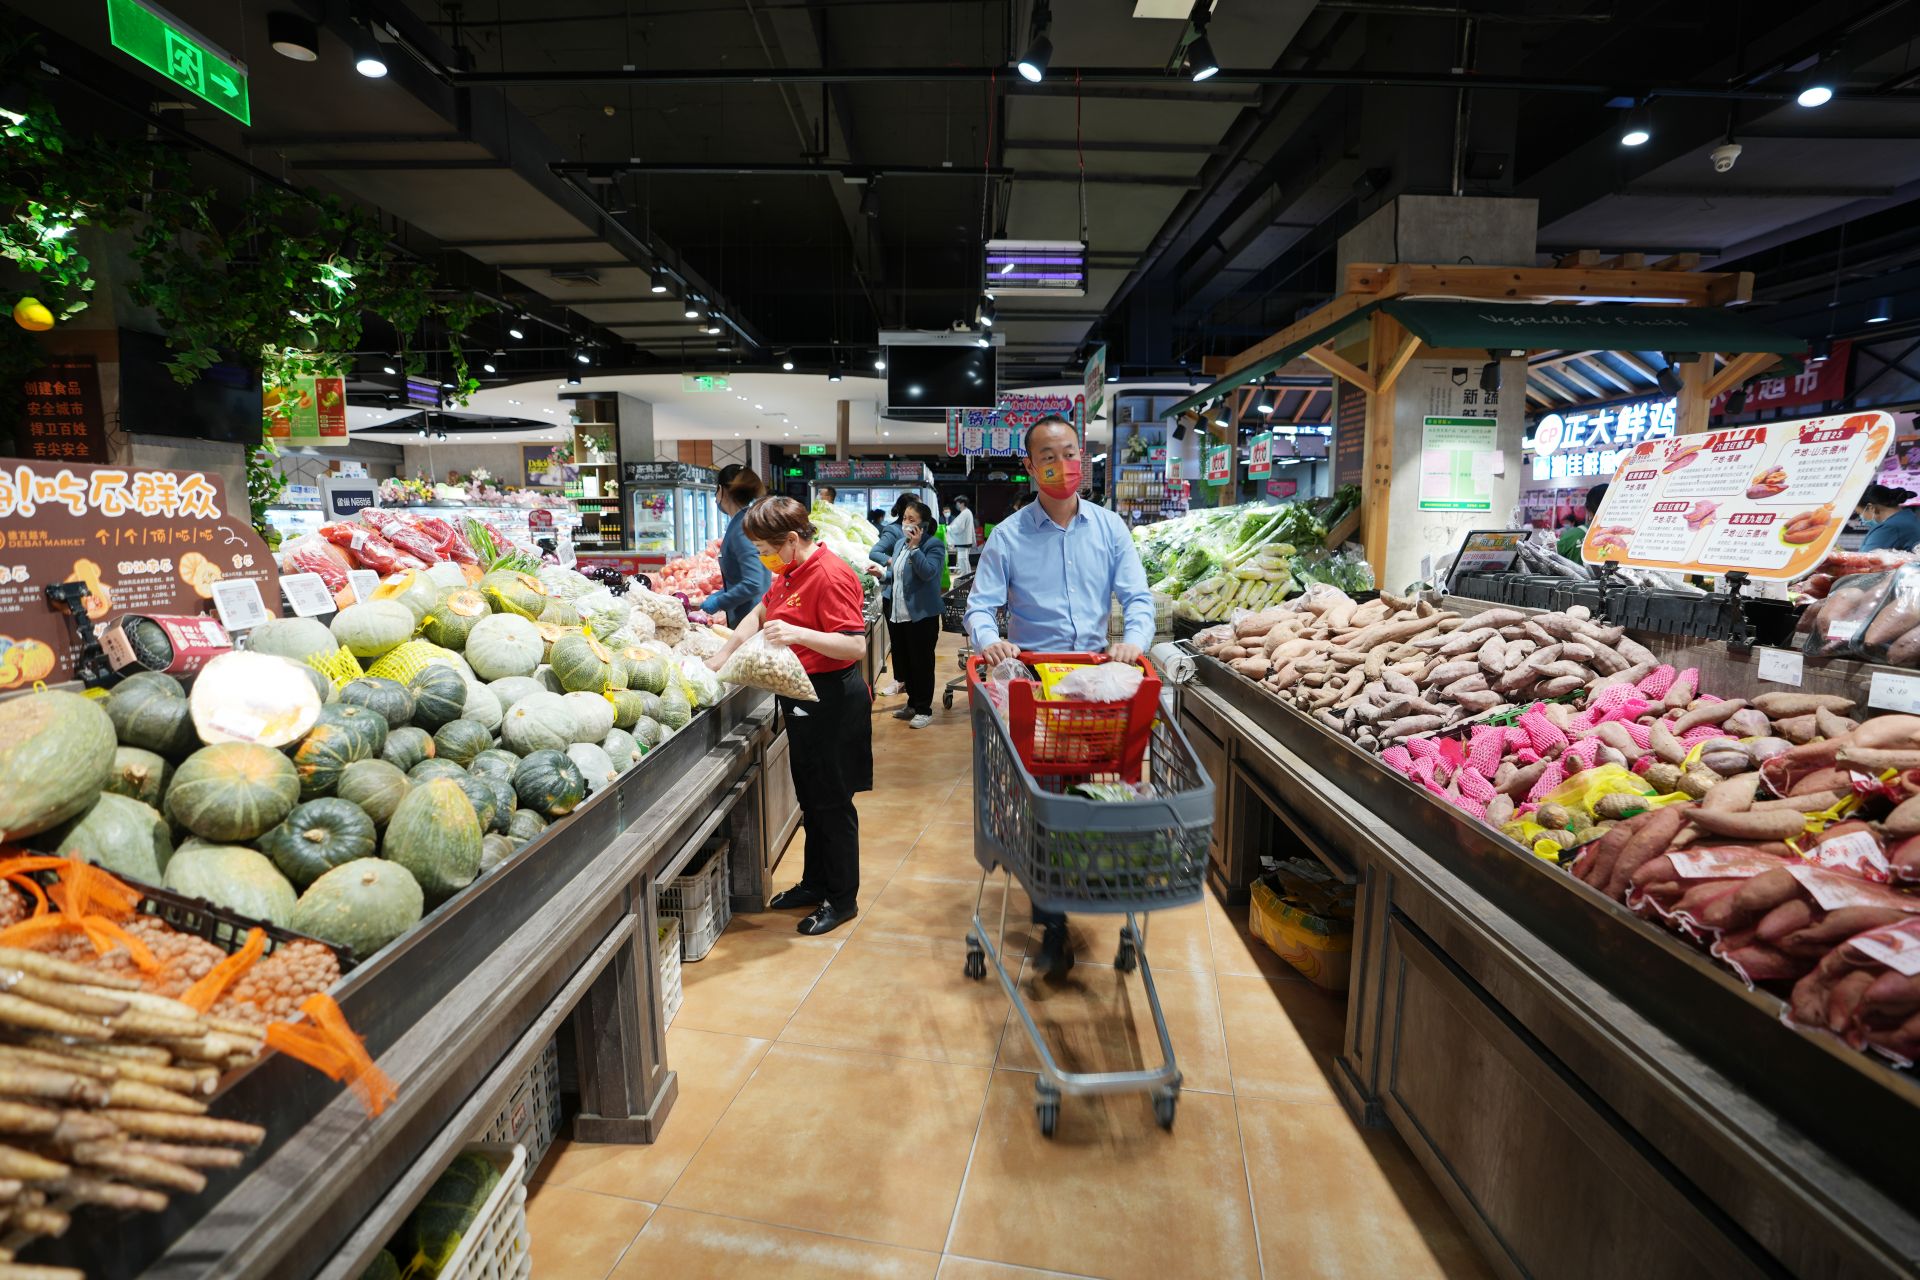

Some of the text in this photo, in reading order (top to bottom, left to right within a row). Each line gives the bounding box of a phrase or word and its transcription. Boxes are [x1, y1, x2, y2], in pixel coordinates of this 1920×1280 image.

[24, 381, 81, 396] 创建食品
[27, 401, 83, 416] 安全城市
[31, 422, 88, 436] 捍卫百姓
[1560, 397, 1678, 449] 正大鲜鸡
[1539, 427, 1558, 445] CP
[33, 442, 89, 456] 舌尖安全
[8, 538, 86, 548] DEBAI MARKET
